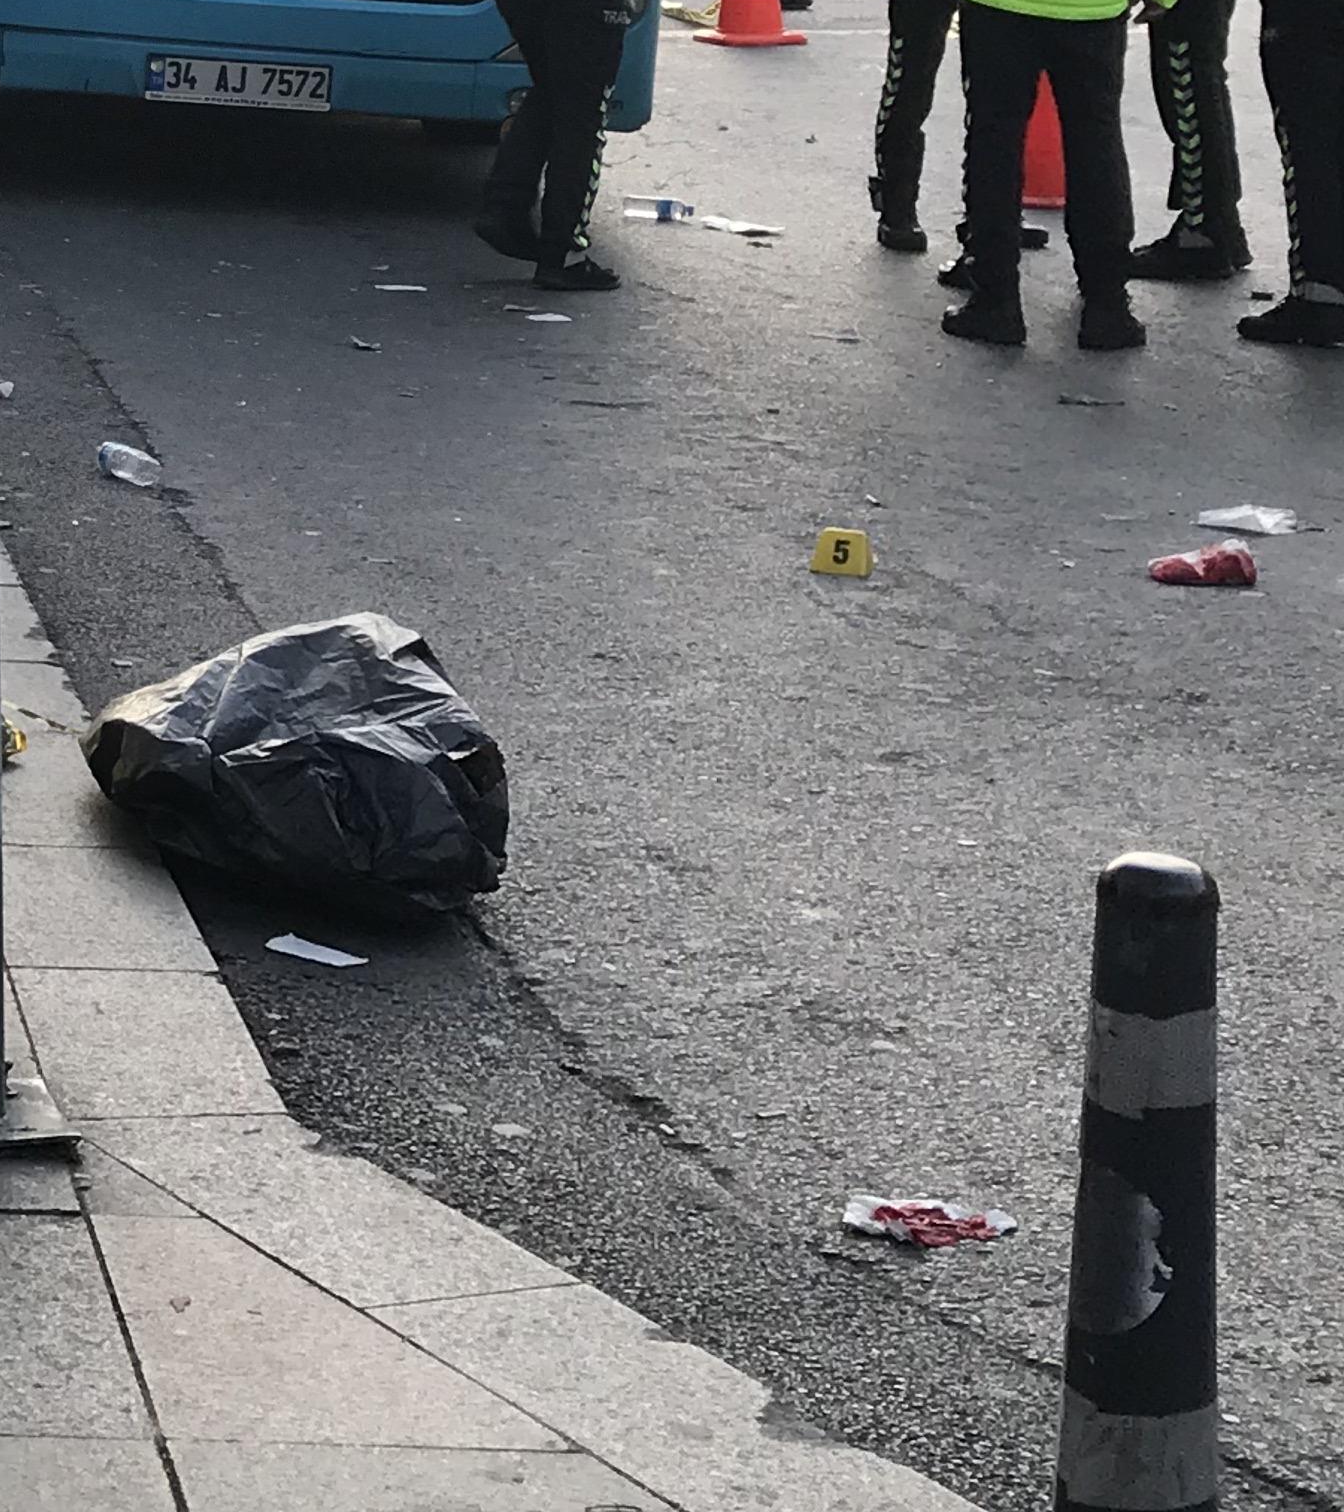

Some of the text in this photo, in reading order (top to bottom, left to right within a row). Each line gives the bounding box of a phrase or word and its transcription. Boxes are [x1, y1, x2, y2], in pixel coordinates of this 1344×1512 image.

[166, 61, 326, 99] 34 AJ 7572
[833, 539, 851, 564] 5
